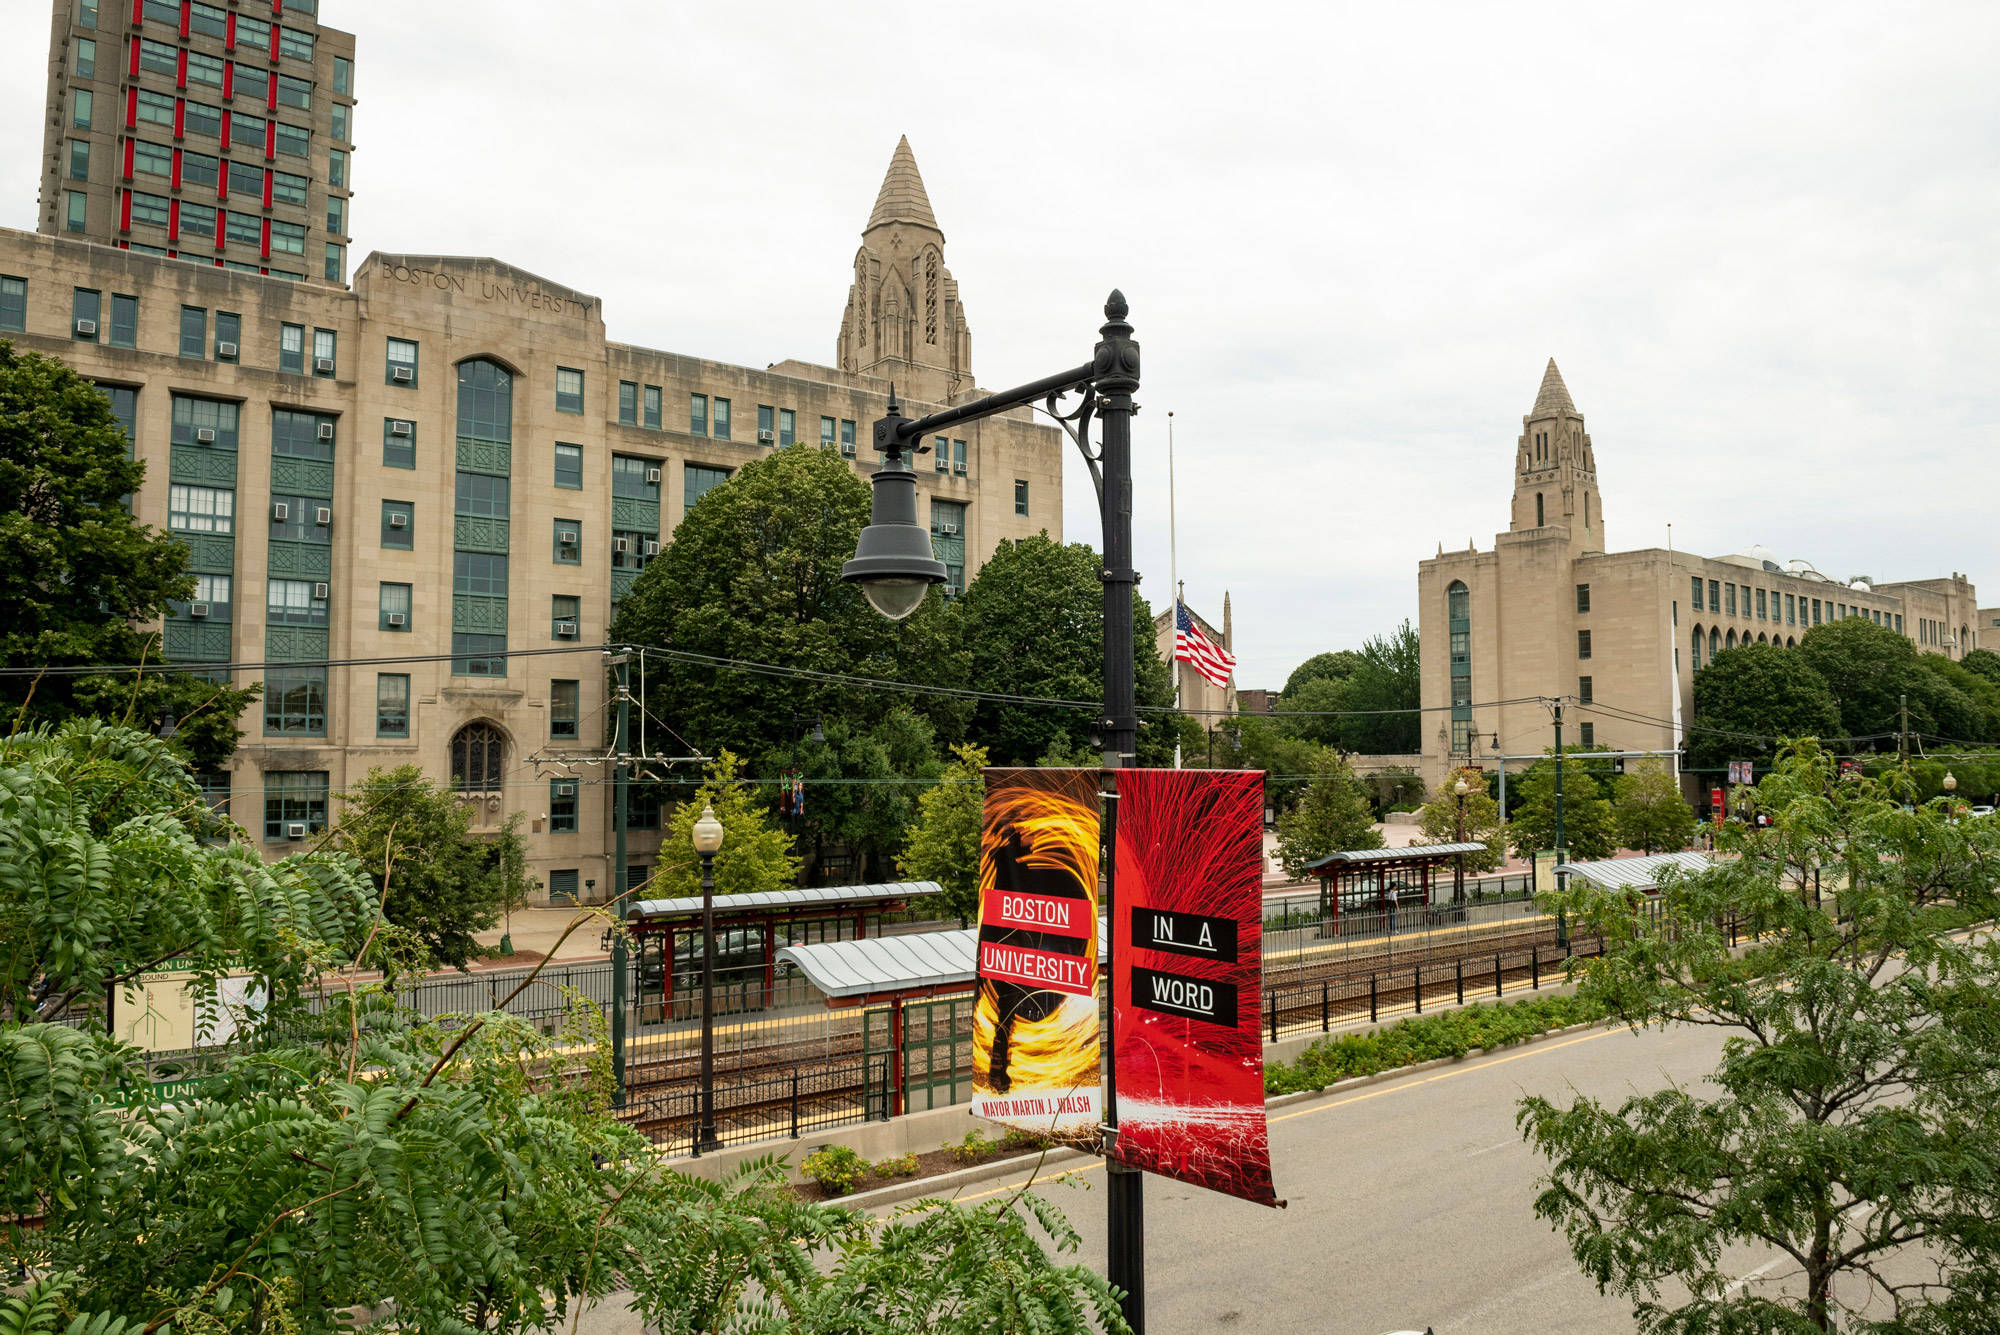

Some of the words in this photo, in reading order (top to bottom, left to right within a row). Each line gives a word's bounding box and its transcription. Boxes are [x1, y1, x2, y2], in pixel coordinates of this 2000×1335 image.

[383, 263, 464, 293] BOSTON
[482, 282, 592, 312] UNIVERSITY
[1002, 895, 1069, 925] BOSTON
[1153, 914, 1174, 941] IN
[1198, 921, 1213, 947] A
[984, 947, 1088, 985] UNIVERSITY
[1151, 975, 1214, 1011] WORD
[982, 1101, 1011, 1117] MAYOR
[1011, 1098, 1045, 1116] MARTIN
[1047, 1097, 1056, 1115] J.
[1057, 1095, 1091, 1114] WALSH
